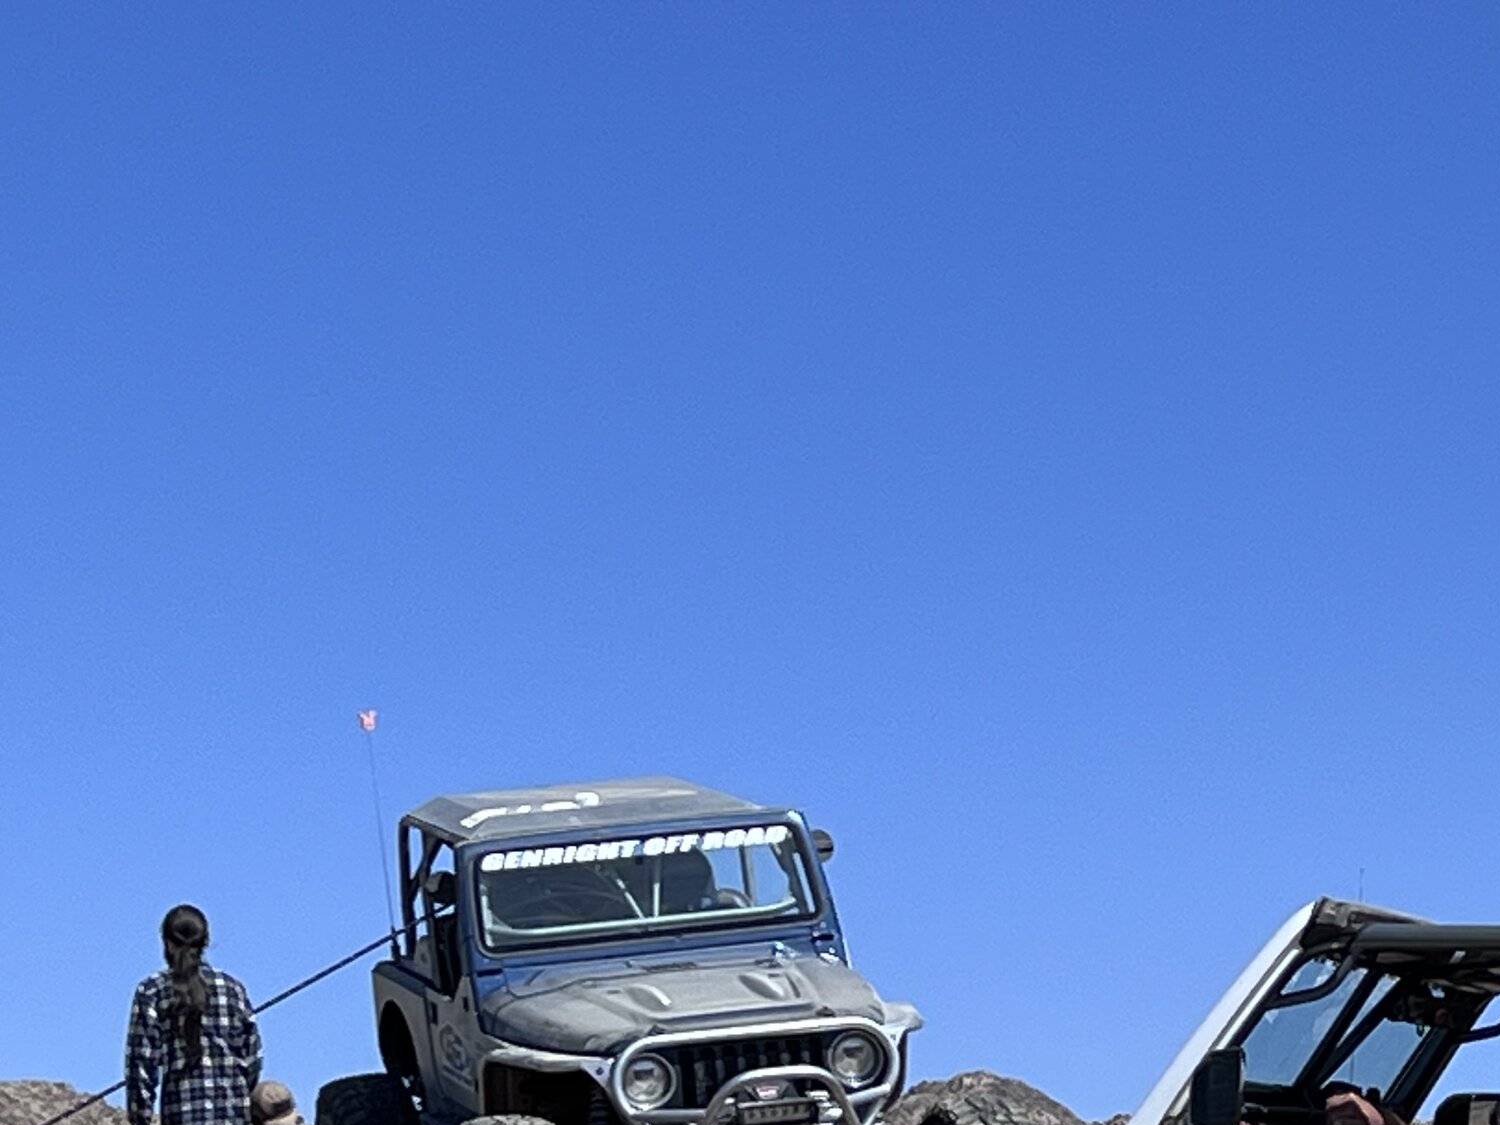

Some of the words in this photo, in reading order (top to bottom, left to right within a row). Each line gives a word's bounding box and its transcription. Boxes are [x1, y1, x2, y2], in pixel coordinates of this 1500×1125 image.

[481, 839, 641, 872] GENRIGHT
[642, 833, 700, 856] OFF
[701, 825, 789, 851] ROAD
